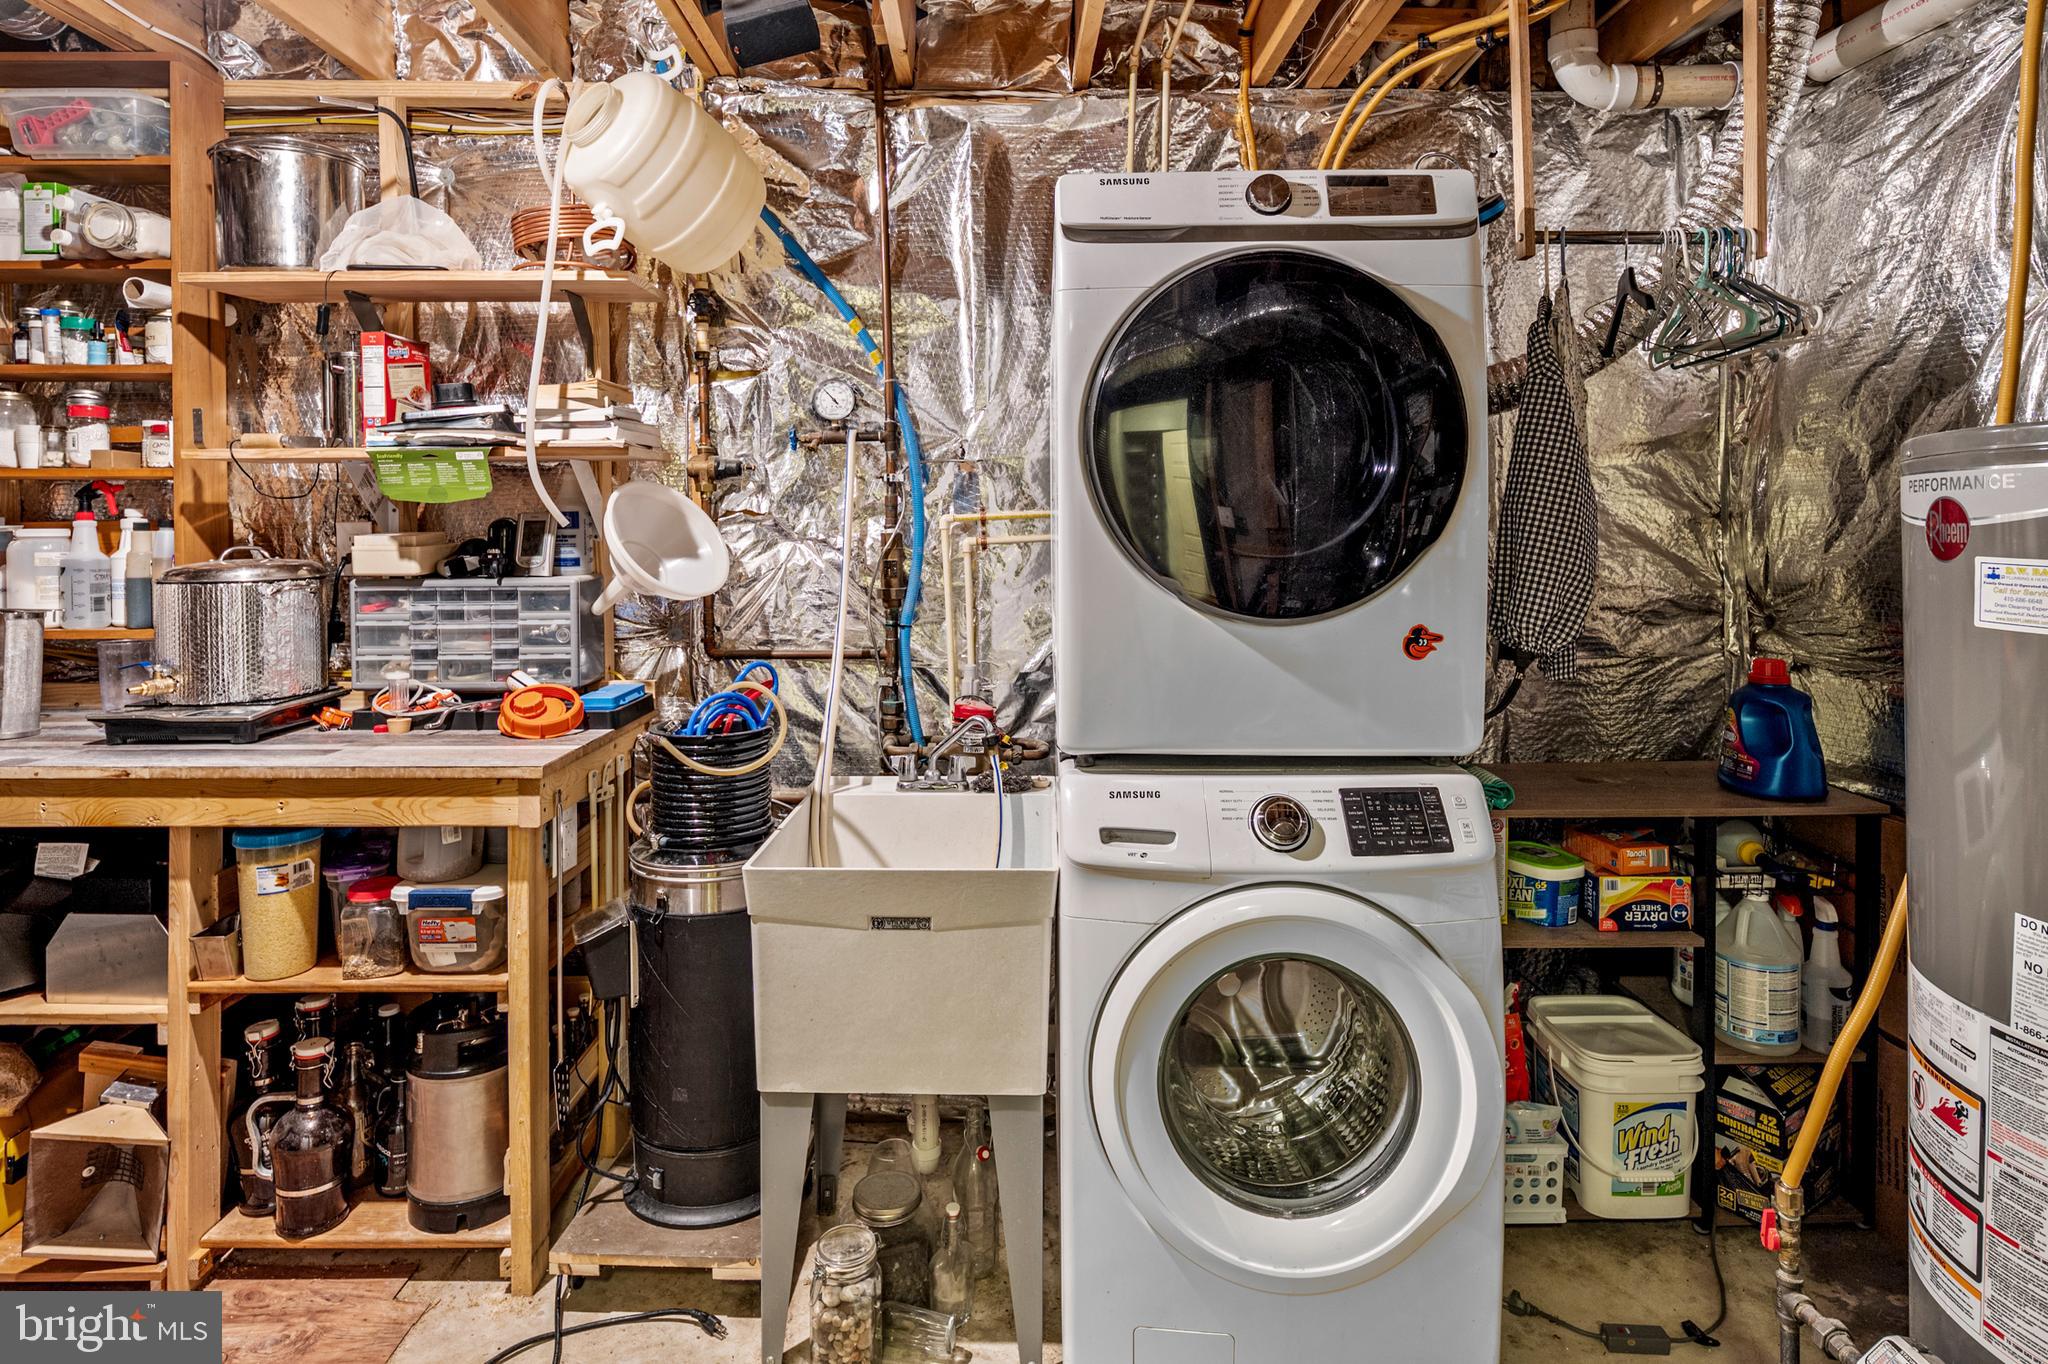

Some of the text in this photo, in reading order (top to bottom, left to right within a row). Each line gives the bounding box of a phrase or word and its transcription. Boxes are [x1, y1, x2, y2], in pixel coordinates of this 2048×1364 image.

[1100, 177, 1150, 186] SAMSUNG
[1908, 473, 2016, 493] PERFORMANCE
[1929, 500, 1968, 552] Rheem
[1109, 790, 1161, 799] SAMSUNG
[1626, 849, 1647, 858] Tandil
[1535, 881, 1547, 889] 65
[1624, 911, 1668, 921] DRYER
[2020, 918, 2037, 931] DO
[2024, 960, 2043, 975] NO
[2005, 1035, 2039, 1055] INSTALLATION
[1923, 1061, 1951, 1090] WARNING
[1759, 1113, 1777, 1129] 42
[1618, 1113, 1672, 1154] Wind
[1716, 1113, 1780, 1147] CONTRACTOR
[1756, 1122, 1780, 1136] GALLON
[1624, 1129, 1680, 1171] Fresh
[1926, 1170, 1947, 1196] DANGER
[1719, 1189, 1734, 1201] 24
